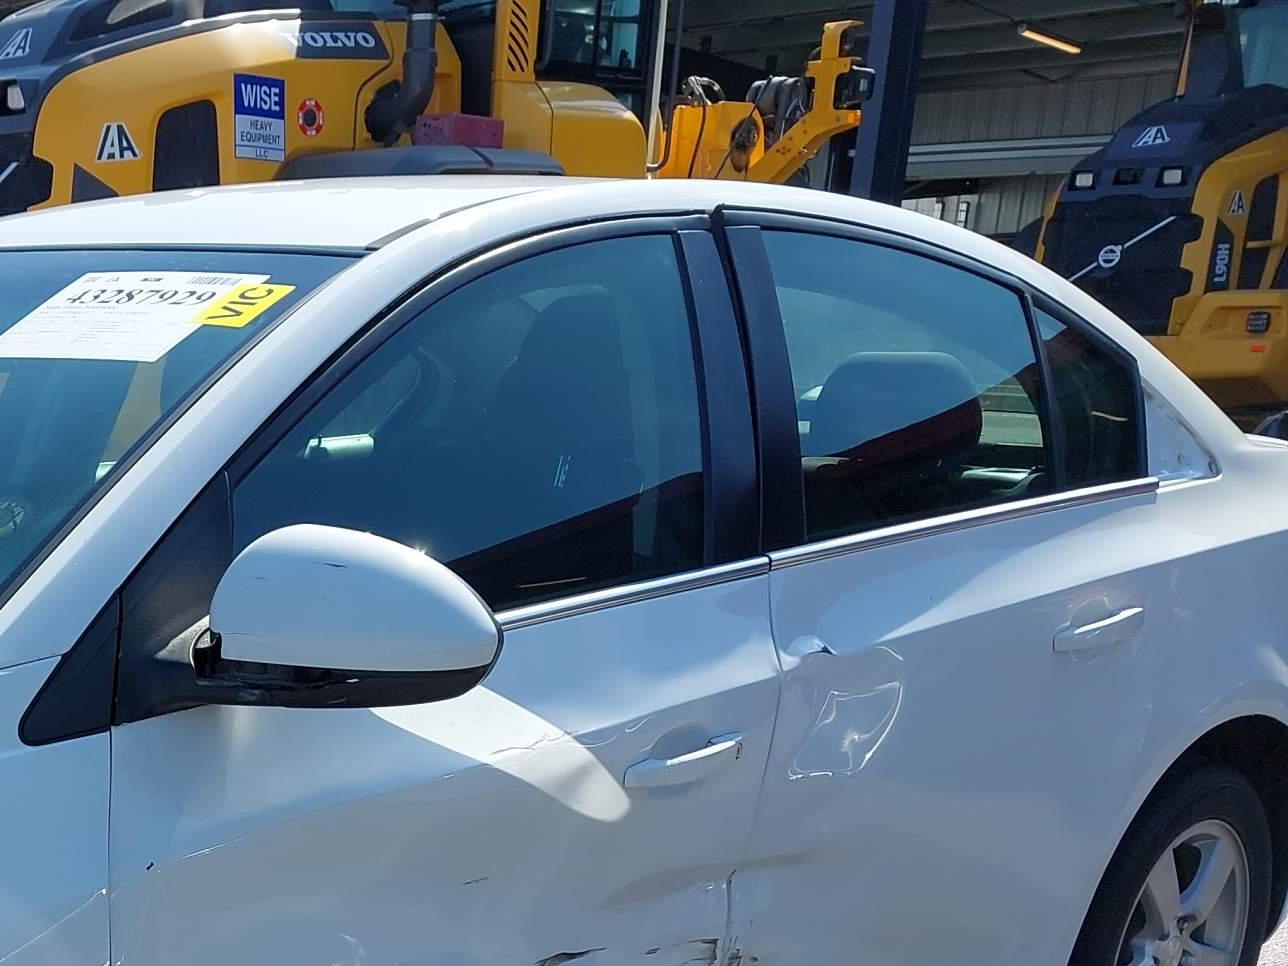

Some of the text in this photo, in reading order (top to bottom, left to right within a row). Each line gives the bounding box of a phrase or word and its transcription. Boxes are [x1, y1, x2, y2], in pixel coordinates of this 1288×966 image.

[279, 31, 376, 48] VOLVO
[240, 82, 281, 112] WISE
[249, 119, 273, 132] HEAVY
[240, 131, 281, 145] EQUIPMENT
[255, 148, 270, 159] LLC
[1214, 243, 1231, 283] L90H
[66, 288, 216, 306] 43287929
[204, 286, 275, 320] VIC
